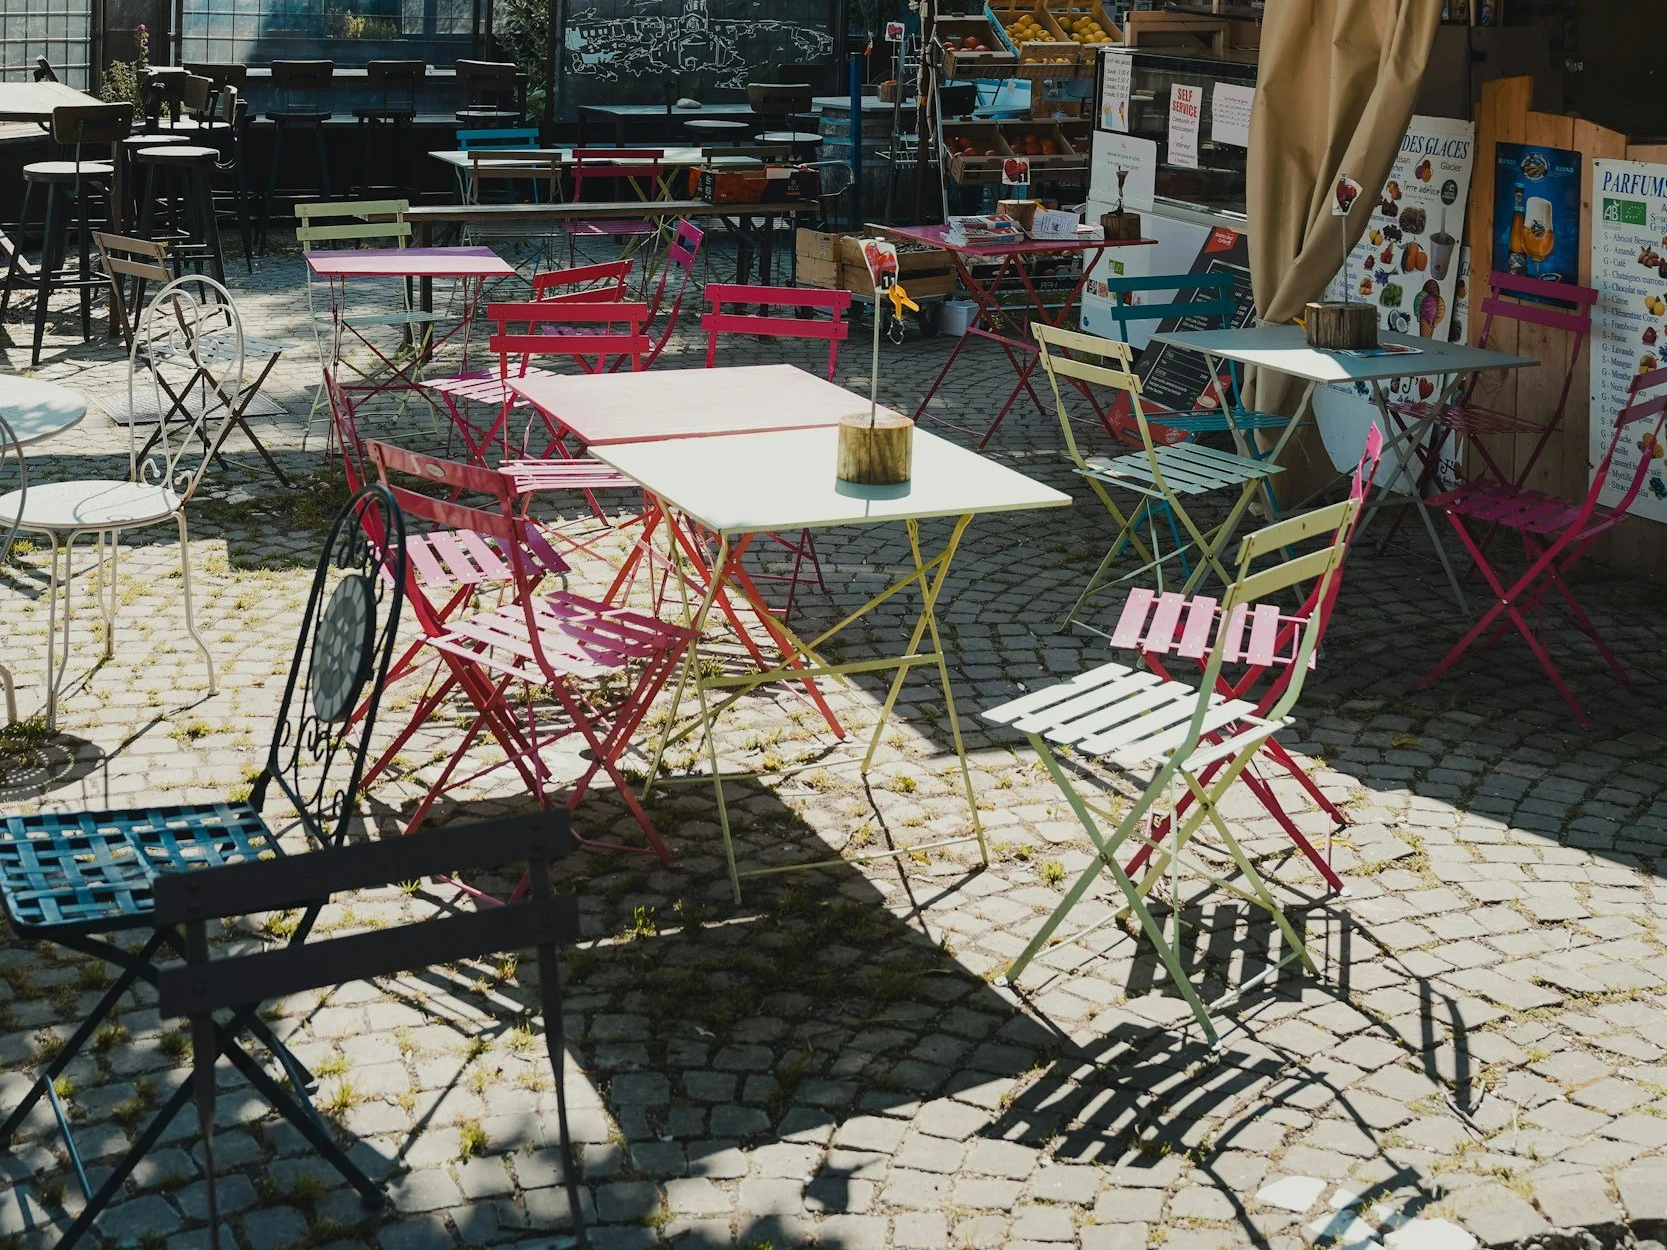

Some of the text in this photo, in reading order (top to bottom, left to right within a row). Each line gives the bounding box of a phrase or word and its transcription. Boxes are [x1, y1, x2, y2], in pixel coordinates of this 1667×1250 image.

[1178, 88, 1192, 102] SELF
[1172, 100, 1198, 118] SERVICE
[1402, 134, 1470, 159] DES GLACES
[1440, 162, 1462, 172] Glacier
[1404, 180, 1418, 192] Terre
[1613, 234, 1632, 244] Abricot
[1634, 236, 1658, 248] Bergeron
[1614, 246, 1636, 256] Amande
[1612, 282, 1636, 294] Chocolat
[1612, 295, 1628, 306] Citron
[1612, 320, 1639, 332] Framboise
[1612, 332, 1627, 342] Fraise
[1612, 345, 1634, 356] Lavande
[1611, 356, 1632, 370] Mangue
[1612, 369, 1632, 382] Menthe
